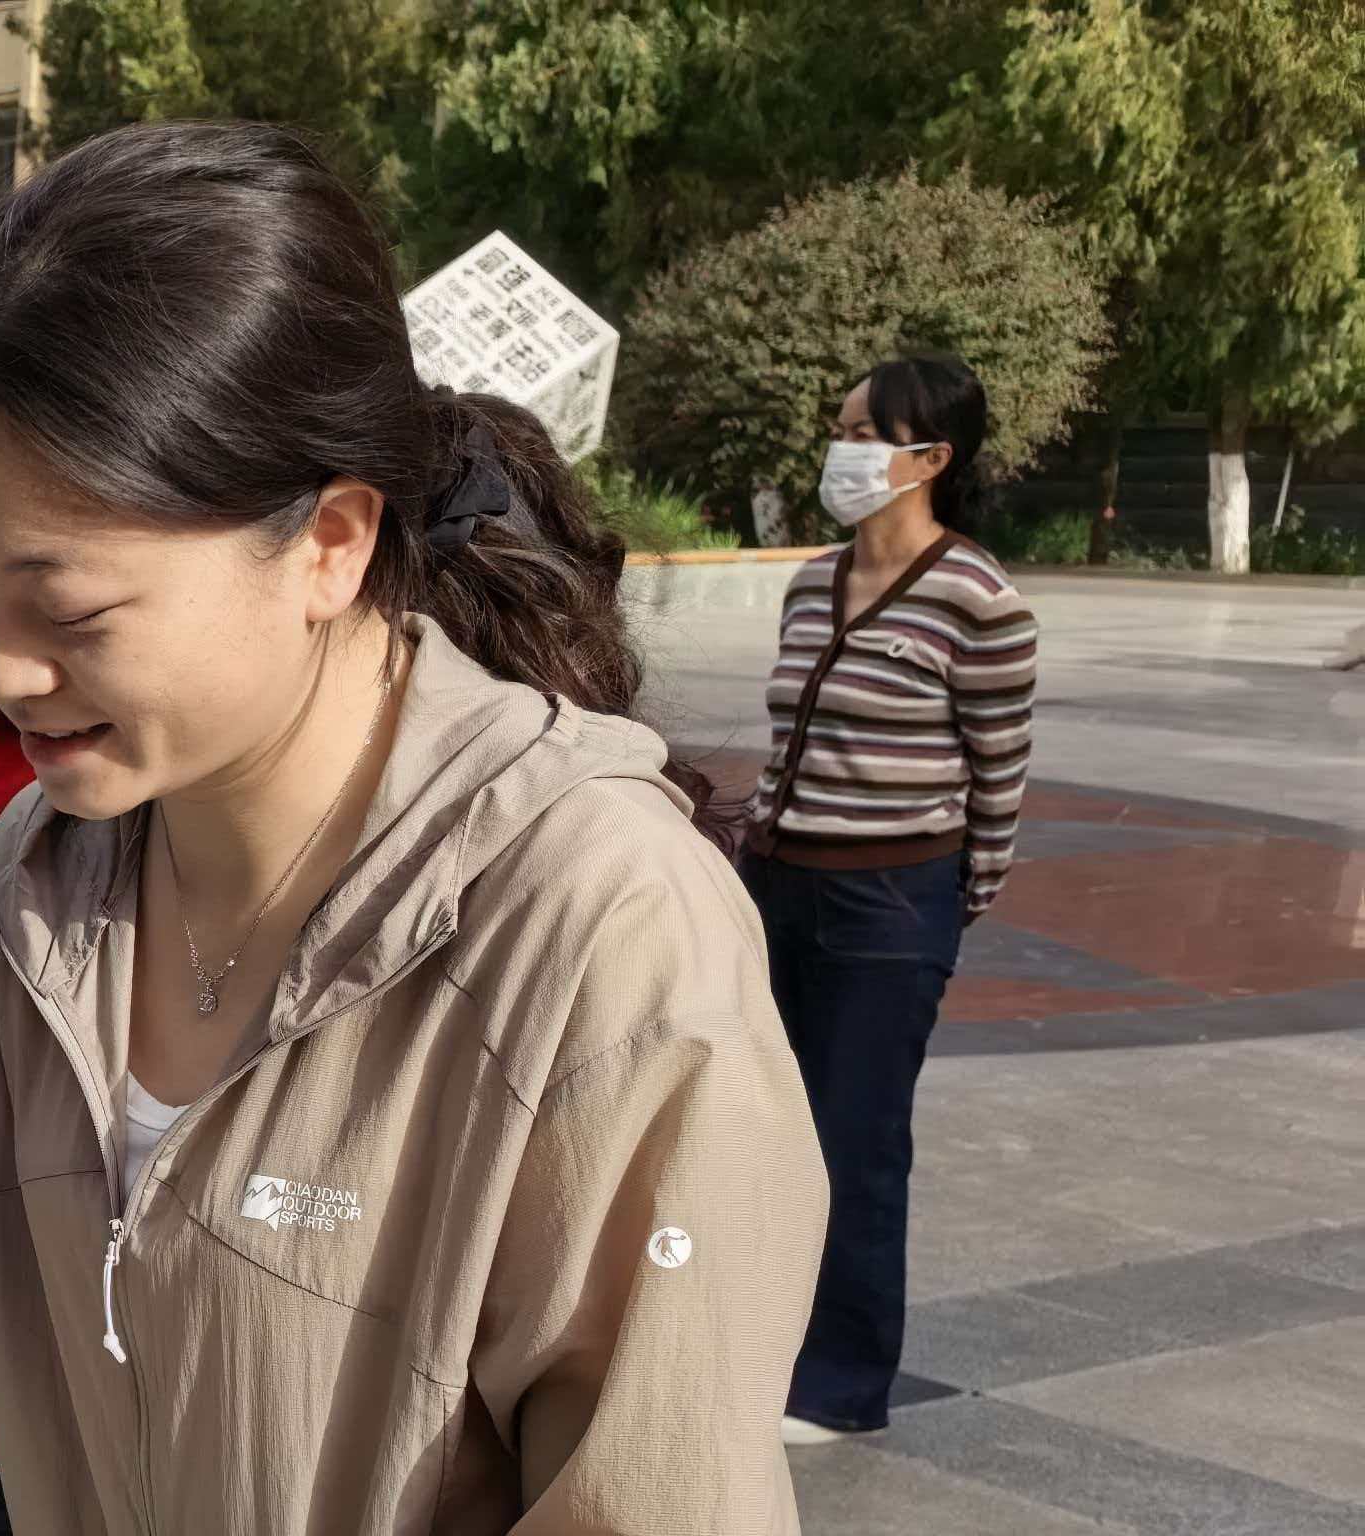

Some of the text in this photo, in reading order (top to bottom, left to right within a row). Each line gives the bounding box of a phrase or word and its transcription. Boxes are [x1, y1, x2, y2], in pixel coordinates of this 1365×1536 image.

[285, 1181, 358, 1206] QIAODAN
[282, 1196, 362, 1220] OUTDOOR
[280, 1211, 335, 1232] SPORTS
